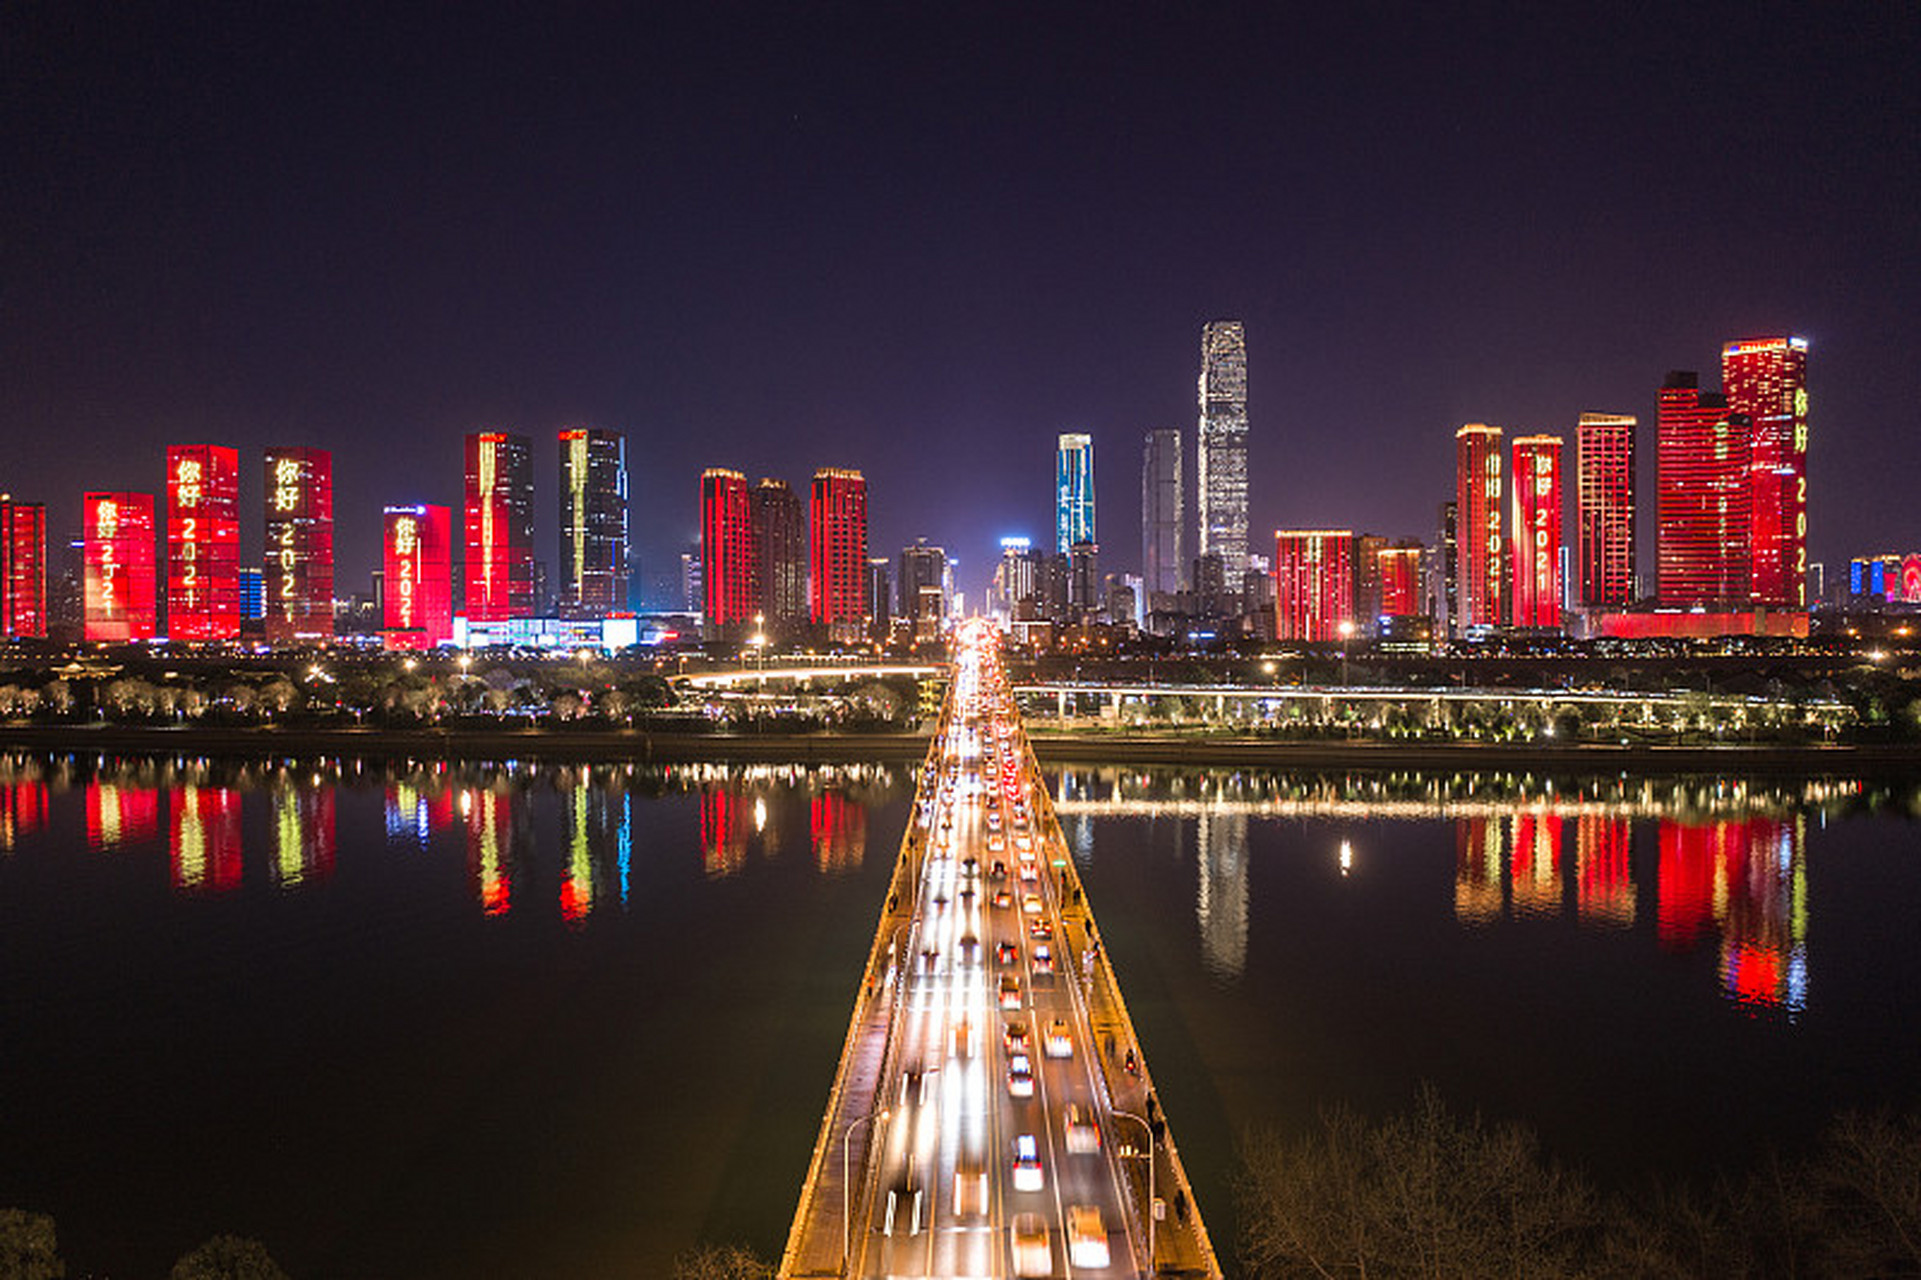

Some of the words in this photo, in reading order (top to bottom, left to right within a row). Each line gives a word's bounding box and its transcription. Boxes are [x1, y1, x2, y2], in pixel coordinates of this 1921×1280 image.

[97, 501, 118, 538] 你好
[177, 460, 201, 507] 你好
[275, 459, 299, 511] 你好
[182, 518, 196, 608] 2021
[281, 523, 295, 622] 2021
[395, 518, 416, 554] 你好
[1488, 511, 1501, 598] 2021
[1536, 509, 1548, 590] 2021
[1796, 477, 1807, 607] 2021
[399, 561, 411, 628] 2021
